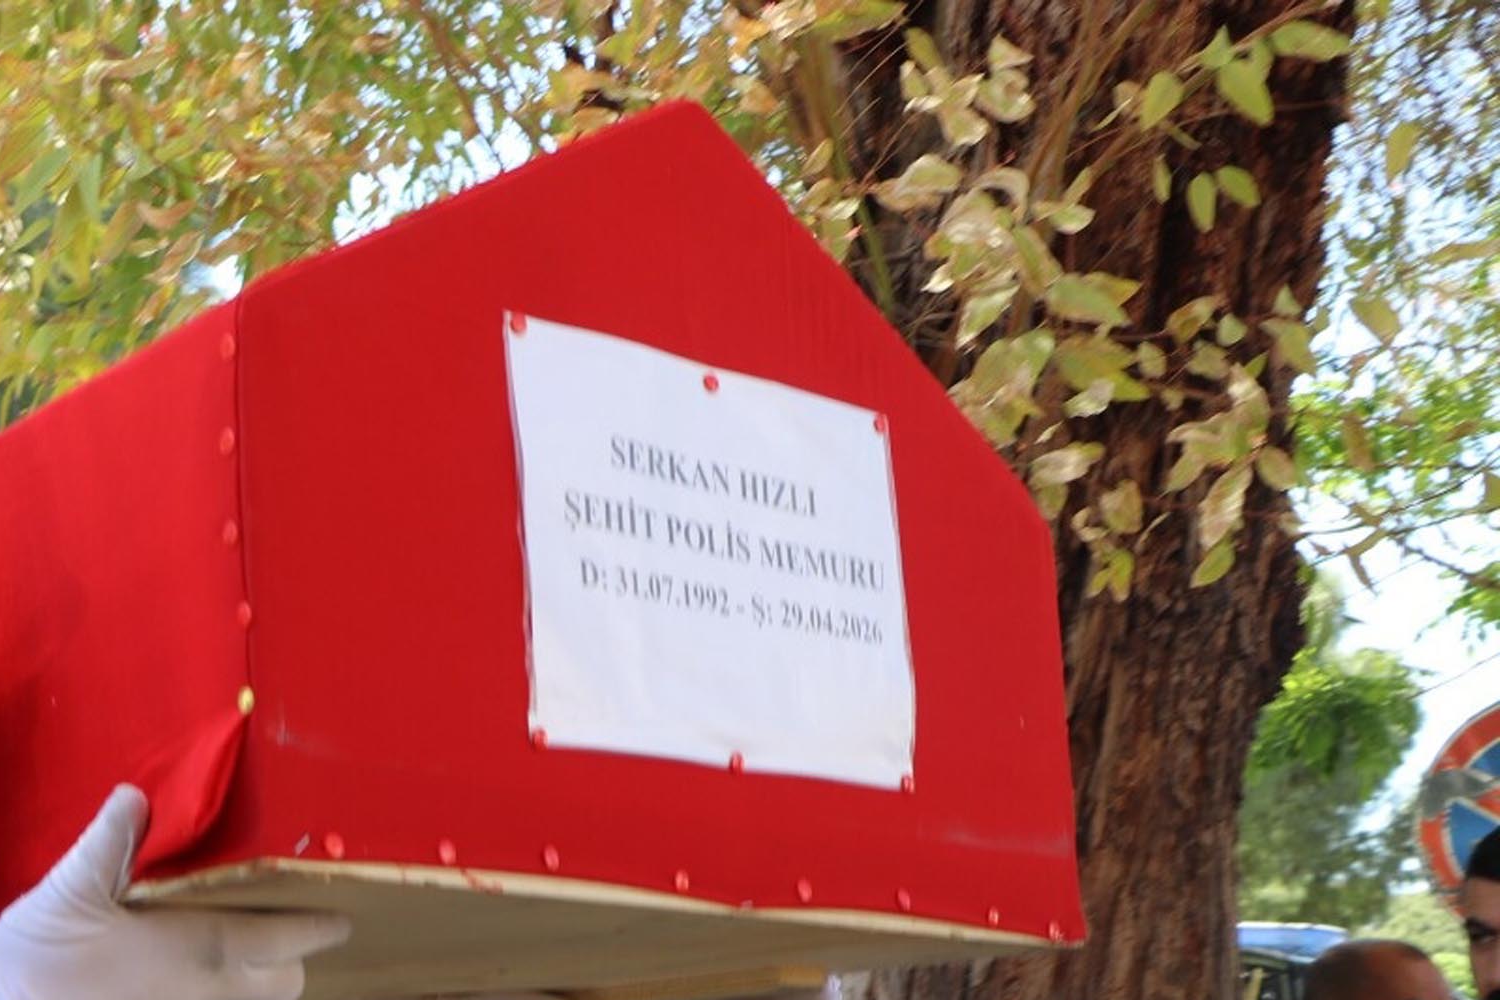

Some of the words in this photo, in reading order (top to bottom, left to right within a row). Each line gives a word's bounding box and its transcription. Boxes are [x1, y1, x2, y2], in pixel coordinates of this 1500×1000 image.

[610, 435, 730, 497] SERKAN
[740, 471, 816, 517] HIZLI
[564, 490, 657, 541] ŞEHİT
[666, 514, 751, 563] POLİS
[759, 537, 885, 592] MEMURU
[581, 559, 609, 591] D:
[614, 565, 730, 617] 31.07.1992
[779, 601, 884, 646] 29.04.2026
